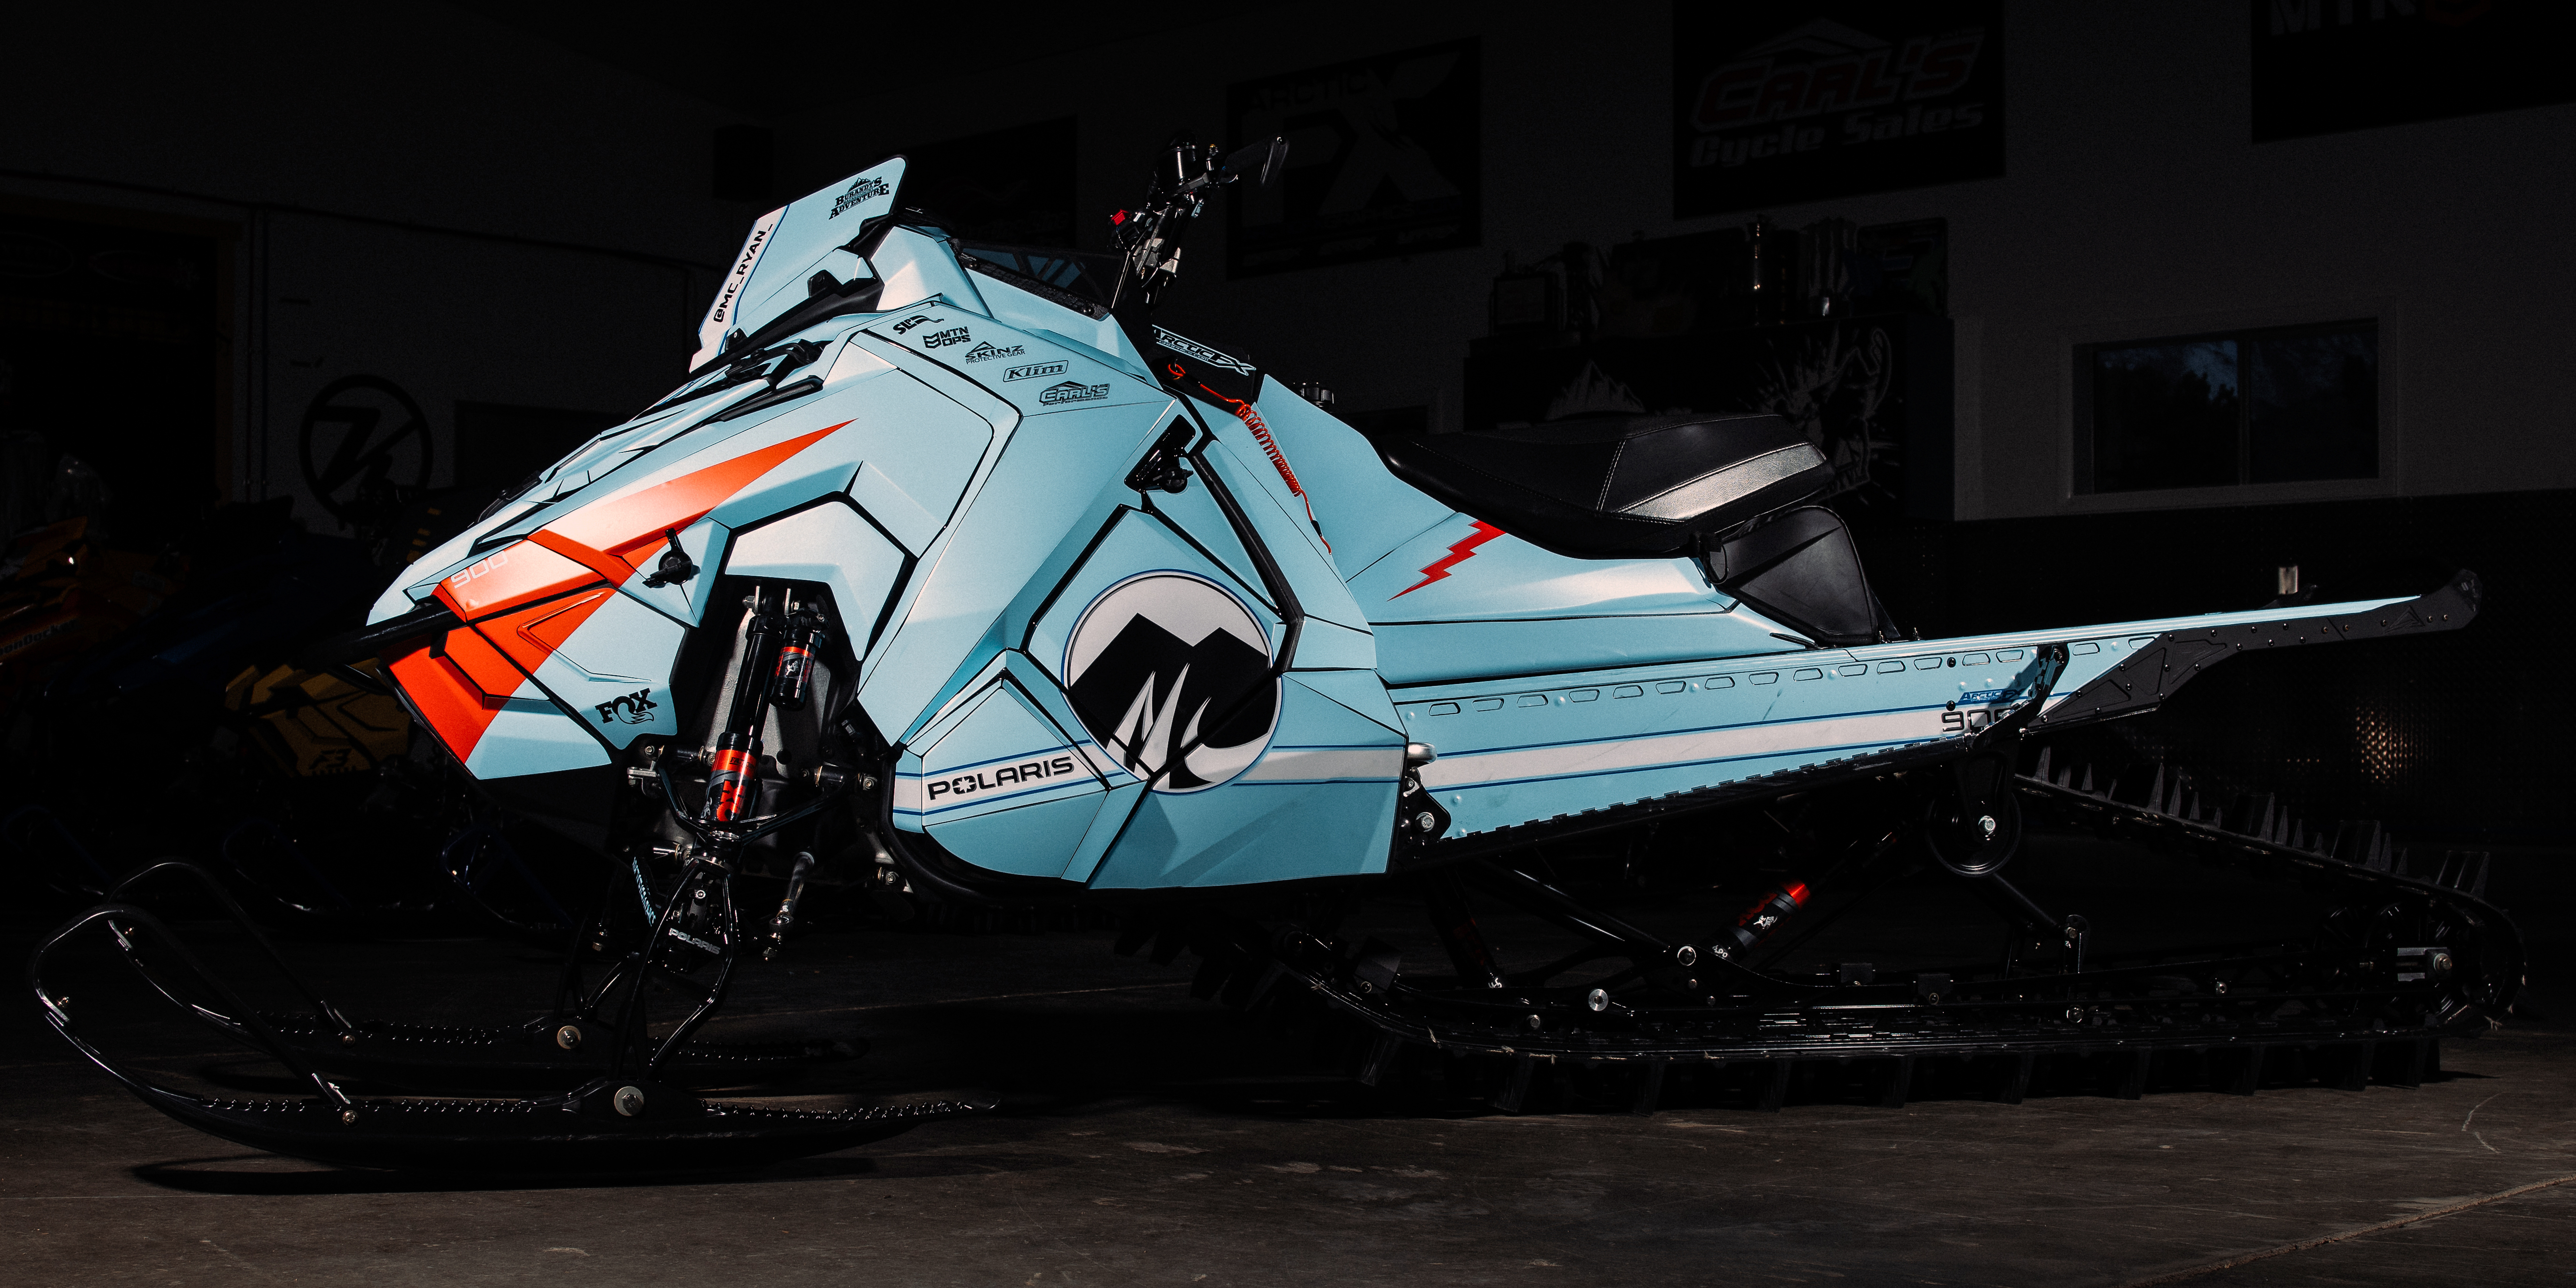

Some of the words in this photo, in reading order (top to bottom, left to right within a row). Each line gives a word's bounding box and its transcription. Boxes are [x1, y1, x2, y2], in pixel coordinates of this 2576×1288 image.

[1248, 72, 1368, 111] ARCTIC
[1690, 123, 1826, 168] Cycle
[1842, 103, 1985, 145] Sales
[828, 183, 890, 220] ADVENTURE
[835, 176, 882, 207] BURANDT'S
[939, 326, 969, 339] MTN
[941, 334, 971, 347] OPS
[965, 345, 1024, 360] SKINZ
[966, 353, 1006, 365] PROTECTIVE
[1039, 383, 1110, 403] CARL'S
[450, 550, 509, 589] 900
[594, 688, 658, 724] FOX
[928, 756, 1075, 801] POLARIS
[668, 927, 721, 955] POLARIS
